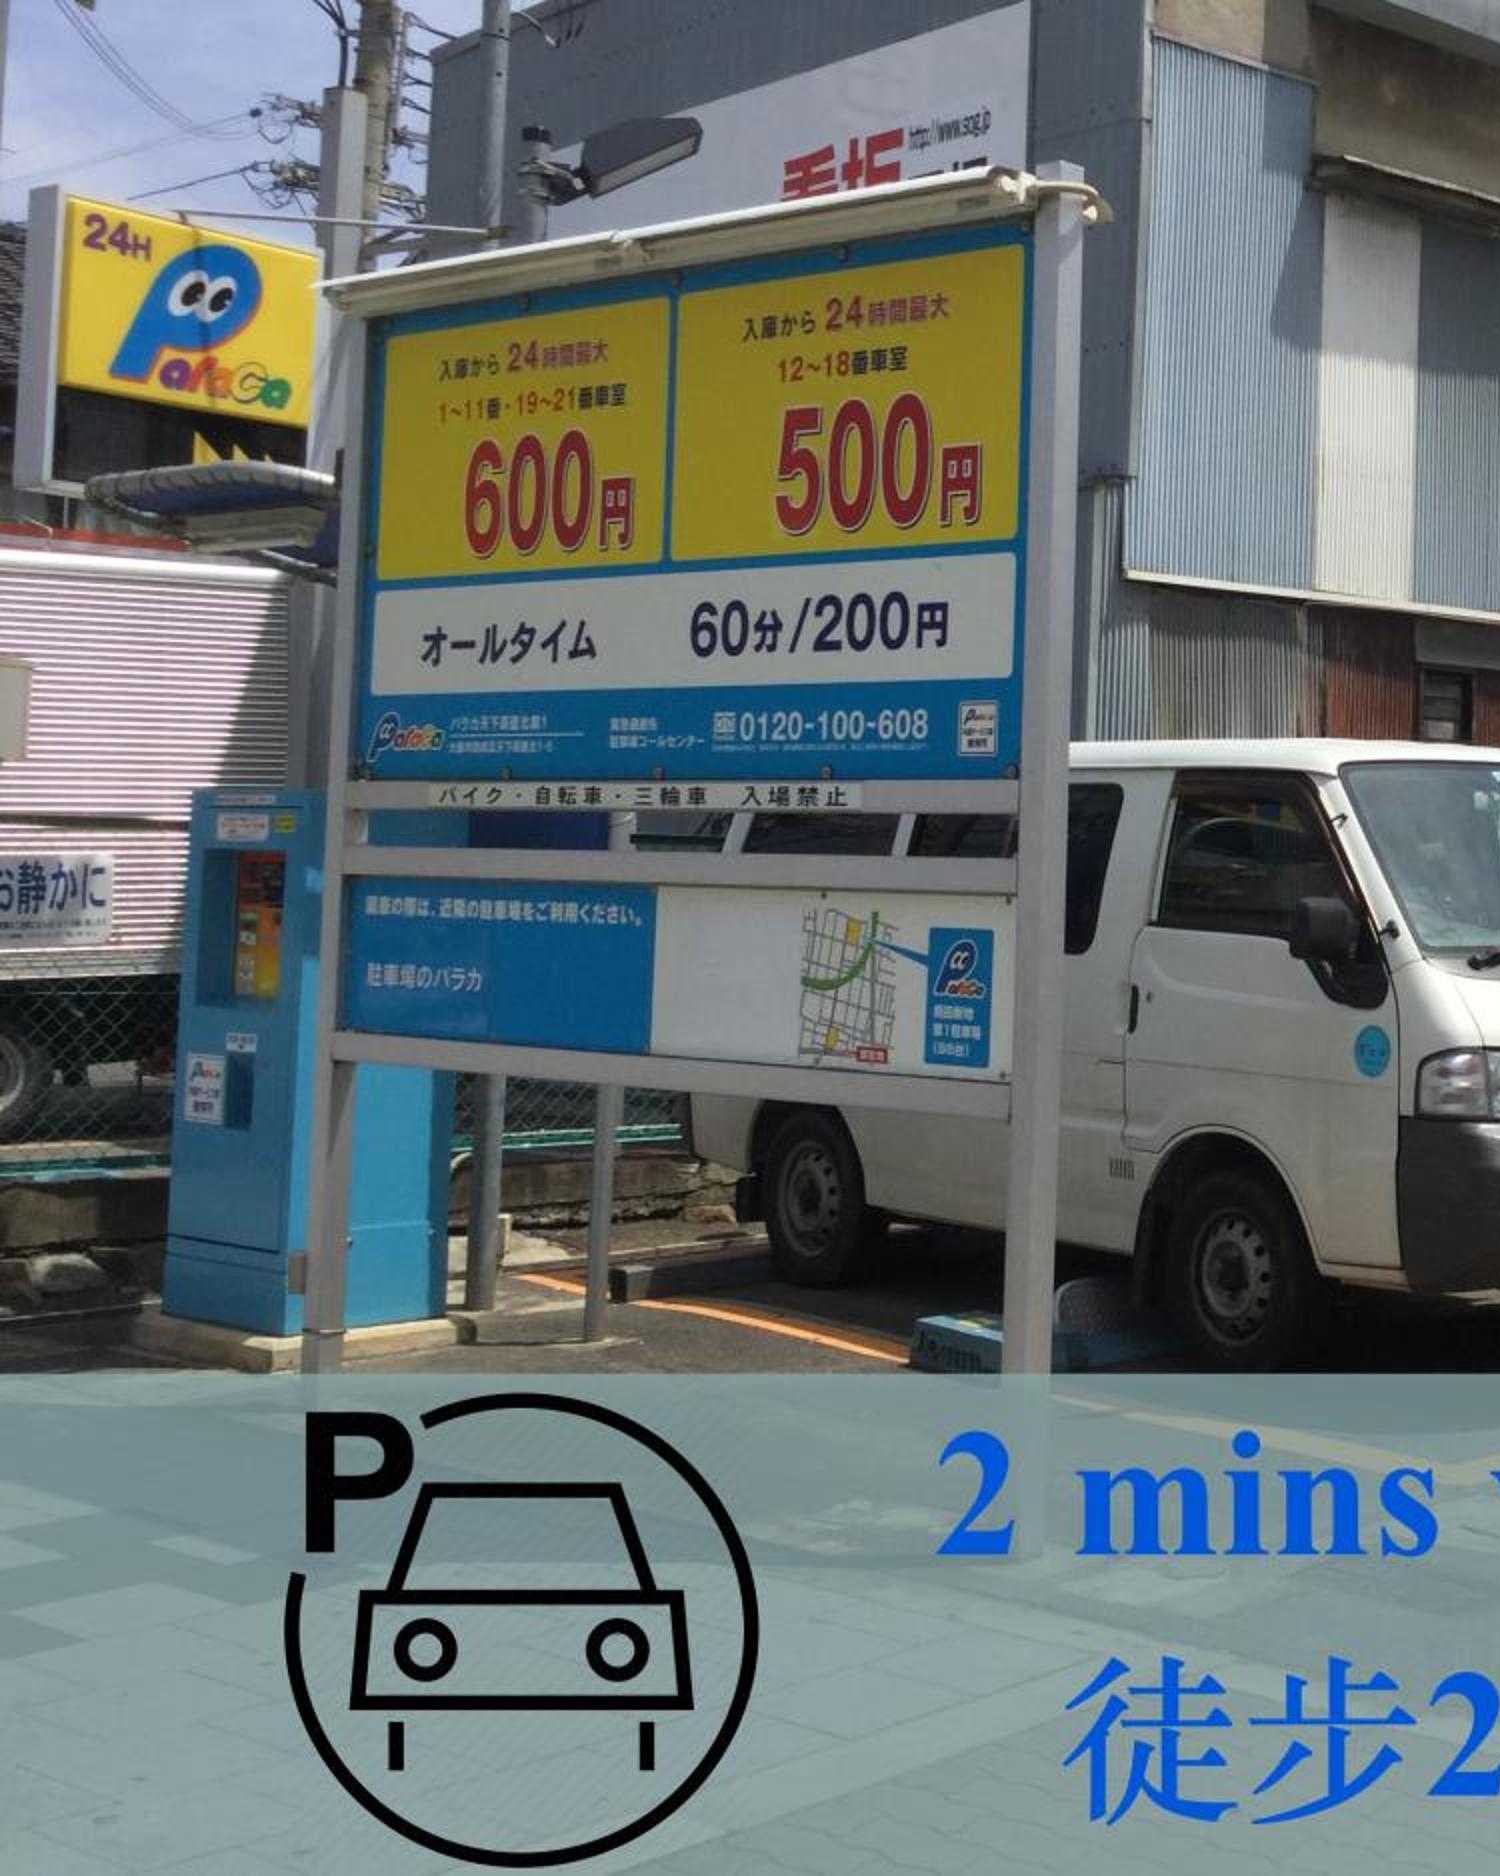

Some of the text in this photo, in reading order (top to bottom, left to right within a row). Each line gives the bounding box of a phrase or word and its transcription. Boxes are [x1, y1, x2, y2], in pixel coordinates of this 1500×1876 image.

[83, 212, 152, 262] 24H
[774, 390, 982, 536] 500円
[466, 427, 636, 559] 600円
[421, 619, 598, 667] オールタイム
[690, 591, 950, 658] 60分/200円
[739, 708, 928, 741] 0120-100-608
[740, 785, 849, 807] 入場禁止
[366, 961, 483, 992] 駐車場のパラカ
